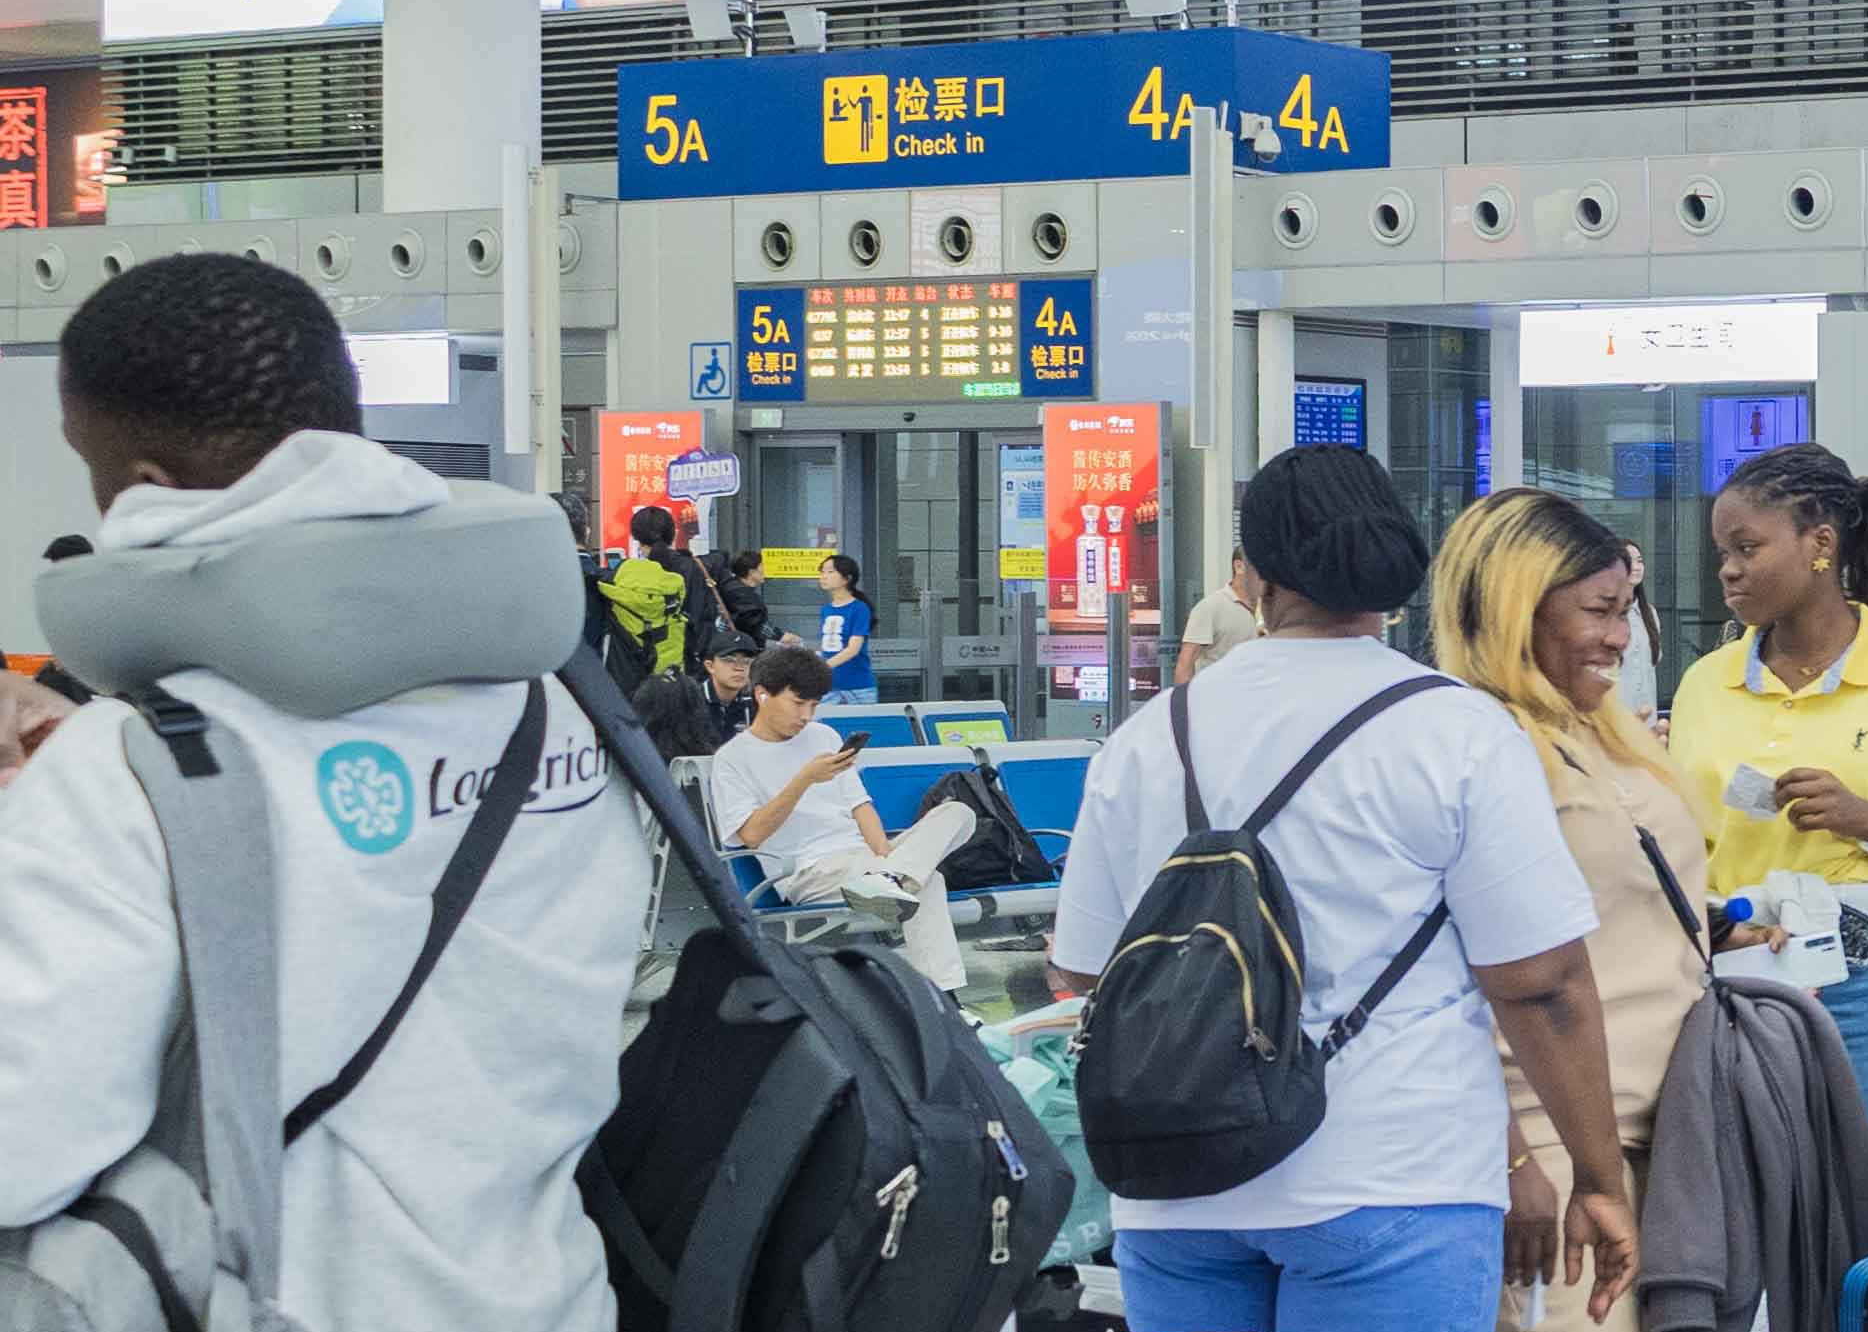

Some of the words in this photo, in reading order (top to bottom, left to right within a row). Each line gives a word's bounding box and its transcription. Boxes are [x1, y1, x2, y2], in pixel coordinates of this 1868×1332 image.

[895, 76, 1006, 122] 检票口
[1128, 66, 1191, 141] 4A
[1280, 74, 1349, 154] 4A
[644, 94, 709, 164] 5A
[895, 131, 959, 158] Check
[965, 132, 984, 154] in
[752, 306, 791, 344] 5A
[1035, 298, 1078, 337] 4A
[747, 352, 797, 373] 检票口
[1031, 346, 1084, 367] 检票口
[1036, 368, 1066, 380] Check
[1068, 368, 1079, 379] in
[752, 374, 783, 385] Check
[785, 373, 792, 384] in
